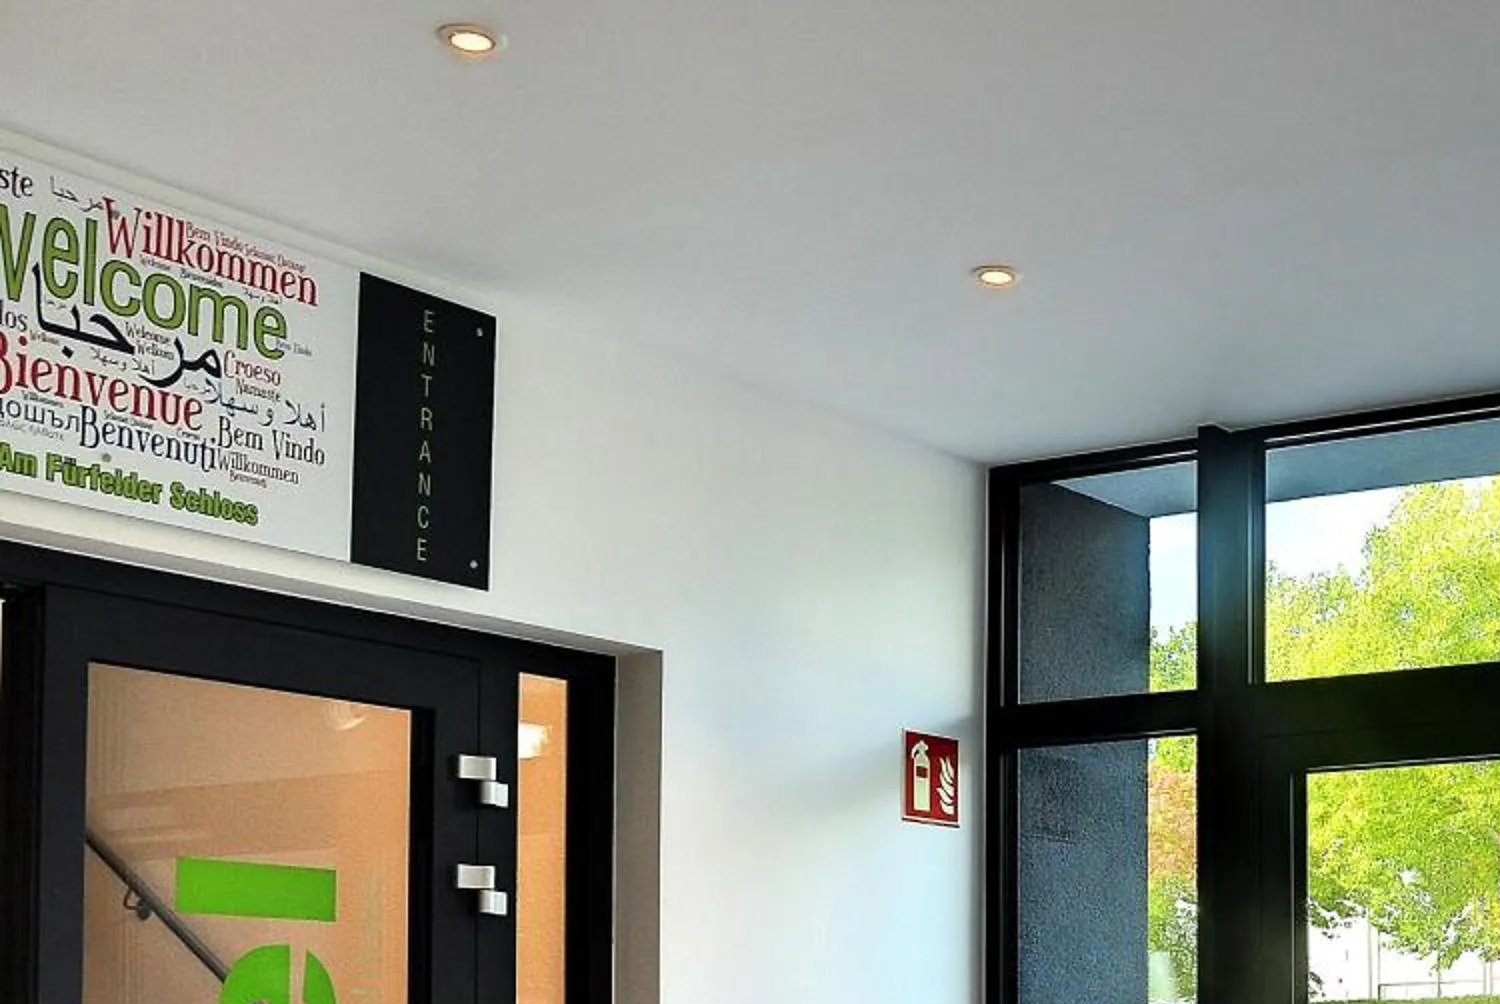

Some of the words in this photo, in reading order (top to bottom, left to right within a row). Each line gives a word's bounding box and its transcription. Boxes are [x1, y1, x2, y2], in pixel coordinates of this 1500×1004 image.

[102, 196, 318, 307] Willkommen
[0, 300, 28, 331] os
[32, 262, 222, 388] مرحبا
[223, 349, 281, 386] Croeso
[79, 403, 218, 472] Benvenuti
[217, 415, 264, 451] Bem
[271, 428, 325, 465] Vindo
[218, 448, 299, 485] Willkommen
[416, 309, 436, 562] ENTRANCE
[0, 442, 38, 479] Am
[46, 451, 163, 504] Fürfelder
[169, 481, 259, 526] Schloss
